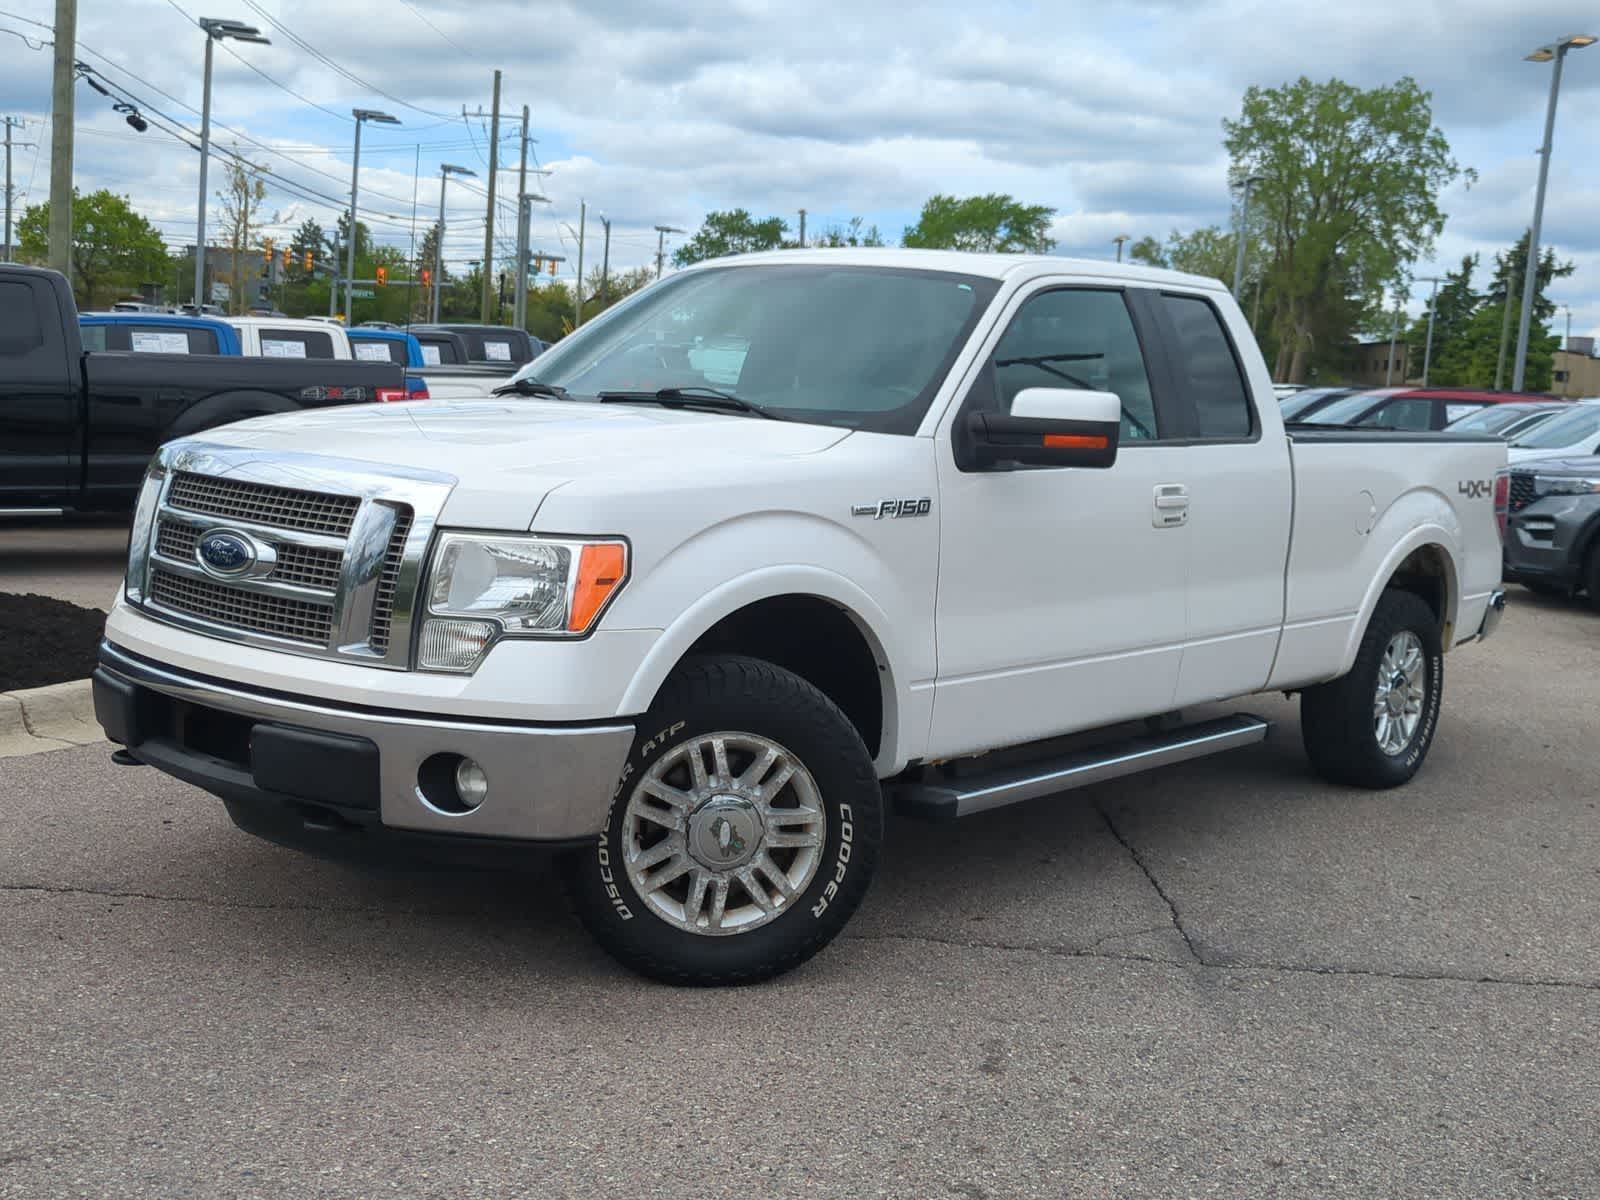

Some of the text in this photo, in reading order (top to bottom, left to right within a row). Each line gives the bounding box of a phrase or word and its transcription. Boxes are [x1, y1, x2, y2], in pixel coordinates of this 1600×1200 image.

[598, 720, 686, 921] DISCOVR ATP
[811, 803, 853, 918] COOPER
